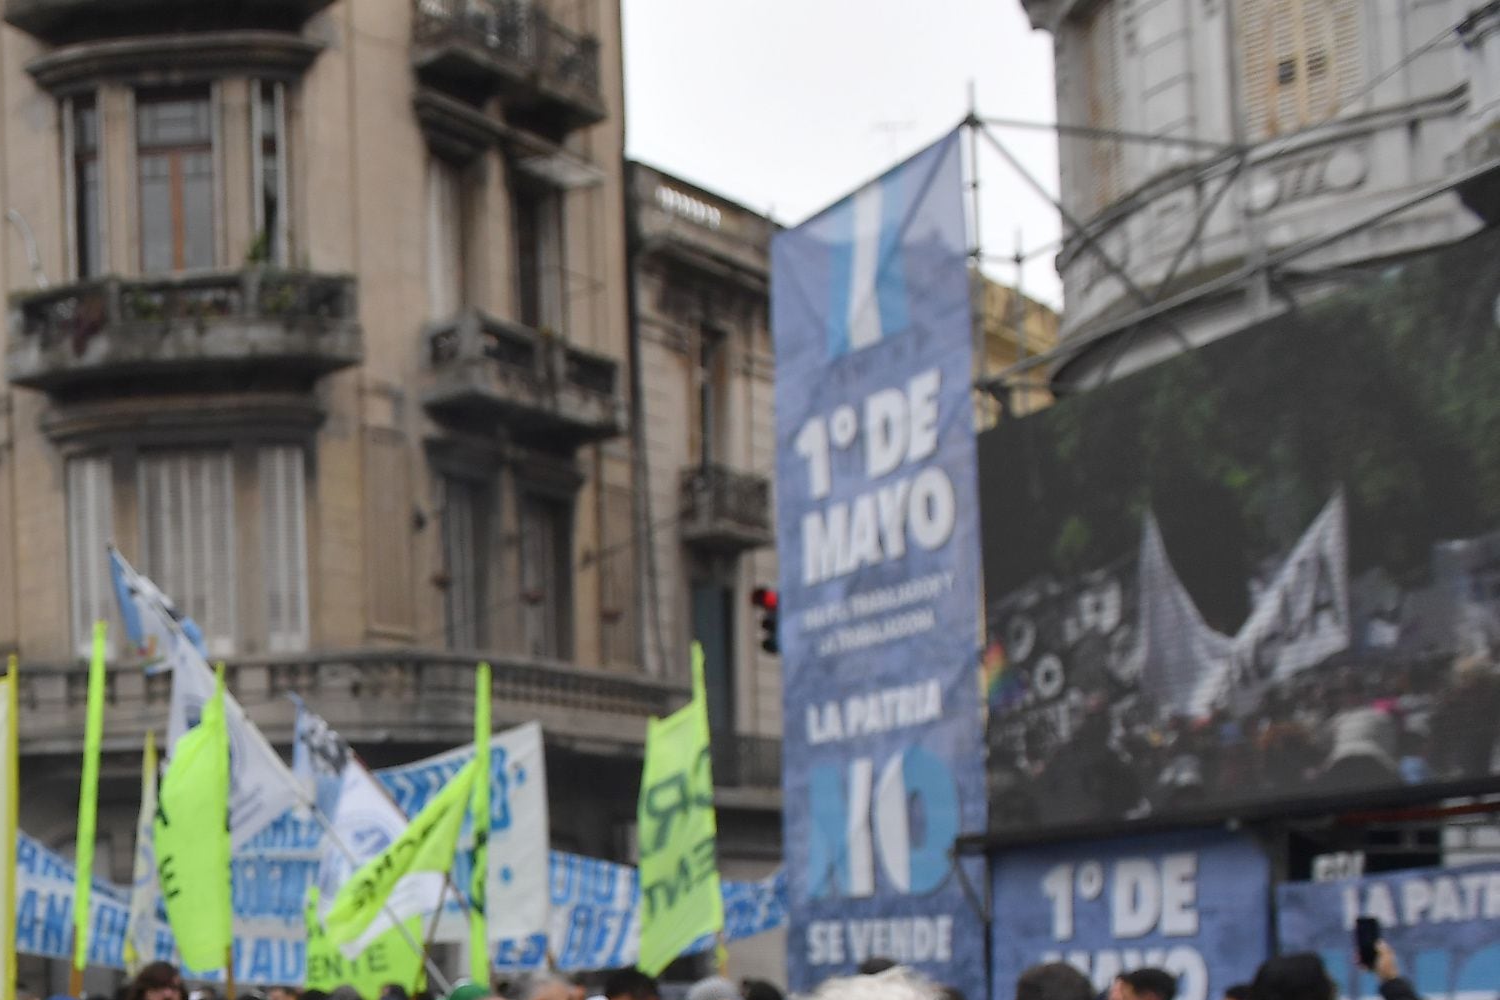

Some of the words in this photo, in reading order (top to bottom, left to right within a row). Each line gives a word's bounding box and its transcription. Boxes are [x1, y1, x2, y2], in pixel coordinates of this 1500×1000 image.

[865, 366, 942, 481] DE
[801, 464, 957, 587] MAYO
[806, 701, 844, 745] LA
[845, 679, 943, 738] PATRIA
[1111, 853, 1200, 939] DE
[807, 919, 845, 965] SE
[847, 914, 954, 963] VENDE
